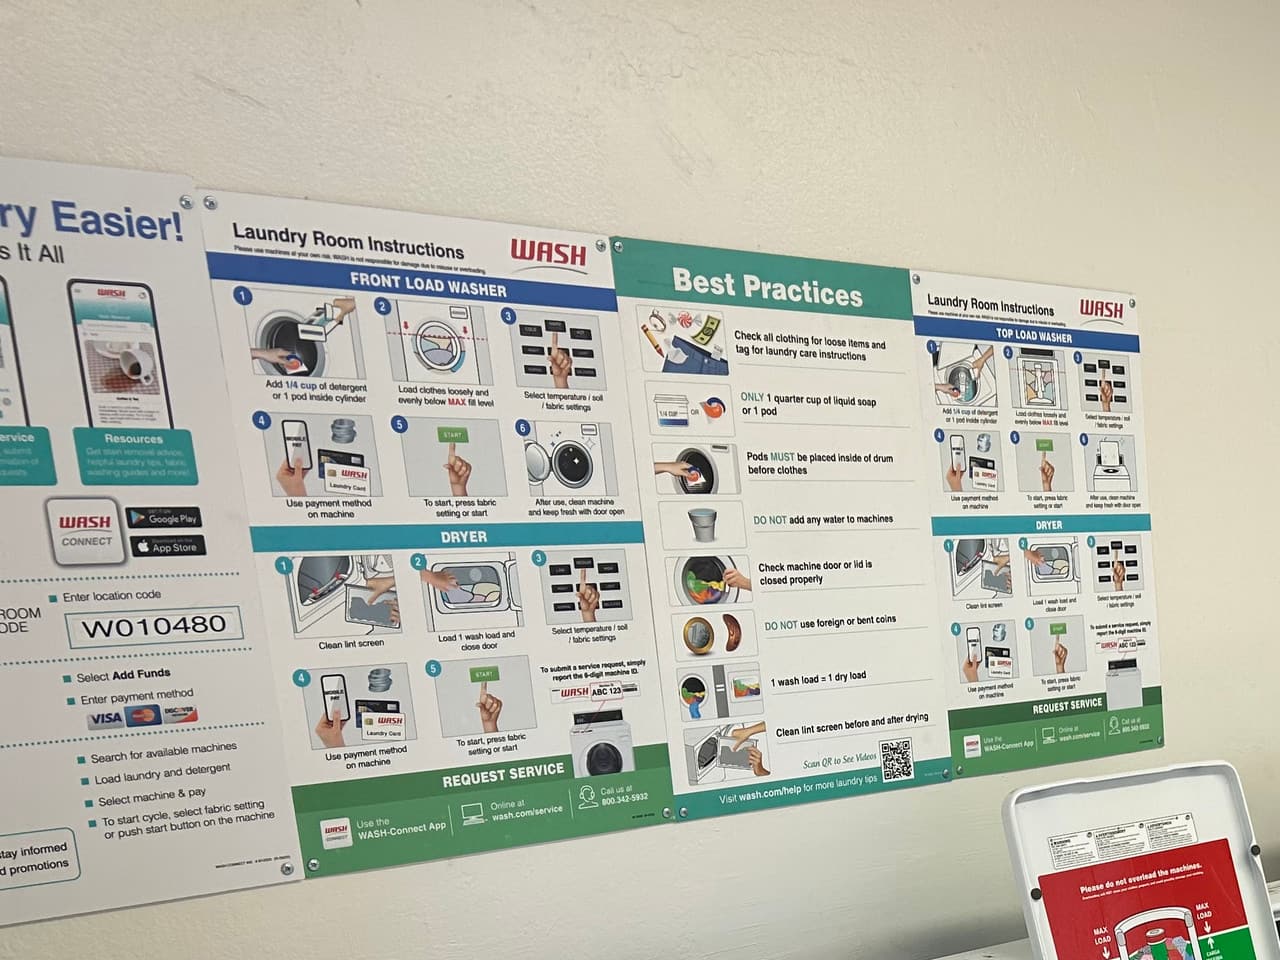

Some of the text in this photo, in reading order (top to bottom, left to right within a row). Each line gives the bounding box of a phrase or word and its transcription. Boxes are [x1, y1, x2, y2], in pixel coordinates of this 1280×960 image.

[52, 200, 184, 242] Easier!
[232, 222, 308, 249] Laundry
[312, 230, 364, 250] Room
[367, 235, 465, 260] Instructions
[17, 242, 65, 264] It All
[511, 239, 587, 266] WASH
[350, 271, 507, 298] FRONT LOAD WASHER
[672, 267, 863, 308] Best Practices
[927, 293, 1055, 317] Laundry Room Instructions
[1079, 300, 1124, 318] WASH
[734, 329, 887, 350] Check all clothing for loose items and
[996, 327, 1073, 344] TOP LOAD WASHER
[740, 391, 877, 409] ONLY 1 quarter cup of liquid soap
[104, 433, 164, 445] Resources
[746, 451, 894, 464] Pods MUST be placed inside of drum
[285, 496, 373, 509] Use payment method
[60, 517, 111, 529] WASH
[149, 514, 197, 526] Google Play
[753, 514, 894, 527] DO NOT add any water to machines
[1035, 520, 1063, 530] DRYER
[61, 536, 113, 547] CONNECT
[440, 530, 488, 544] DRYER
[152, 543, 197, 554] App Store
[758, 559, 873, 573] Check machine door or lid is
[62, 589, 162, 603] Enter location code
[81, 614, 226, 639] W010480
[318, 639, 385, 650] Clean lint screen
[76, 667, 171, 683] Select Add Funds
[80, 687, 194, 706] Enter payment method
[560, 687, 589, 698] WASH
[592, 687, 622, 697] ABC 123
[1032, 697, 1103, 715] REQUEST SERVICE
[90, 711, 122, 726] VISA
[90, 742, 238, 764] Search for available machines
[94, 762, 231, 785] Load laundry and detergent
[442, 762, 565, 788] REQUEST SERVICE
[600, 784, 633, 796] Call us at
[719, 775, 879, 805] Visit wash.com/help for more laundry tips
[490, 799, 526, 811] Online at
[491, 805, 563, 822] wash.com/service
[356, 818, 390, 830] Use the
[358, 820, 447, 841] WASH-Connect App
[21, 841, 68, 857] informed
[9, 857, 70, 878] promotions
[1079, 861, 1203, 895] Please do not overload the machines.
[1196, 902, 1210, 912] MAX
[1197, 910, 1213, 920] LOAD
[1093, 926, 1109, 936] MAX
[1094, 935, 1112, 946] LOAD
